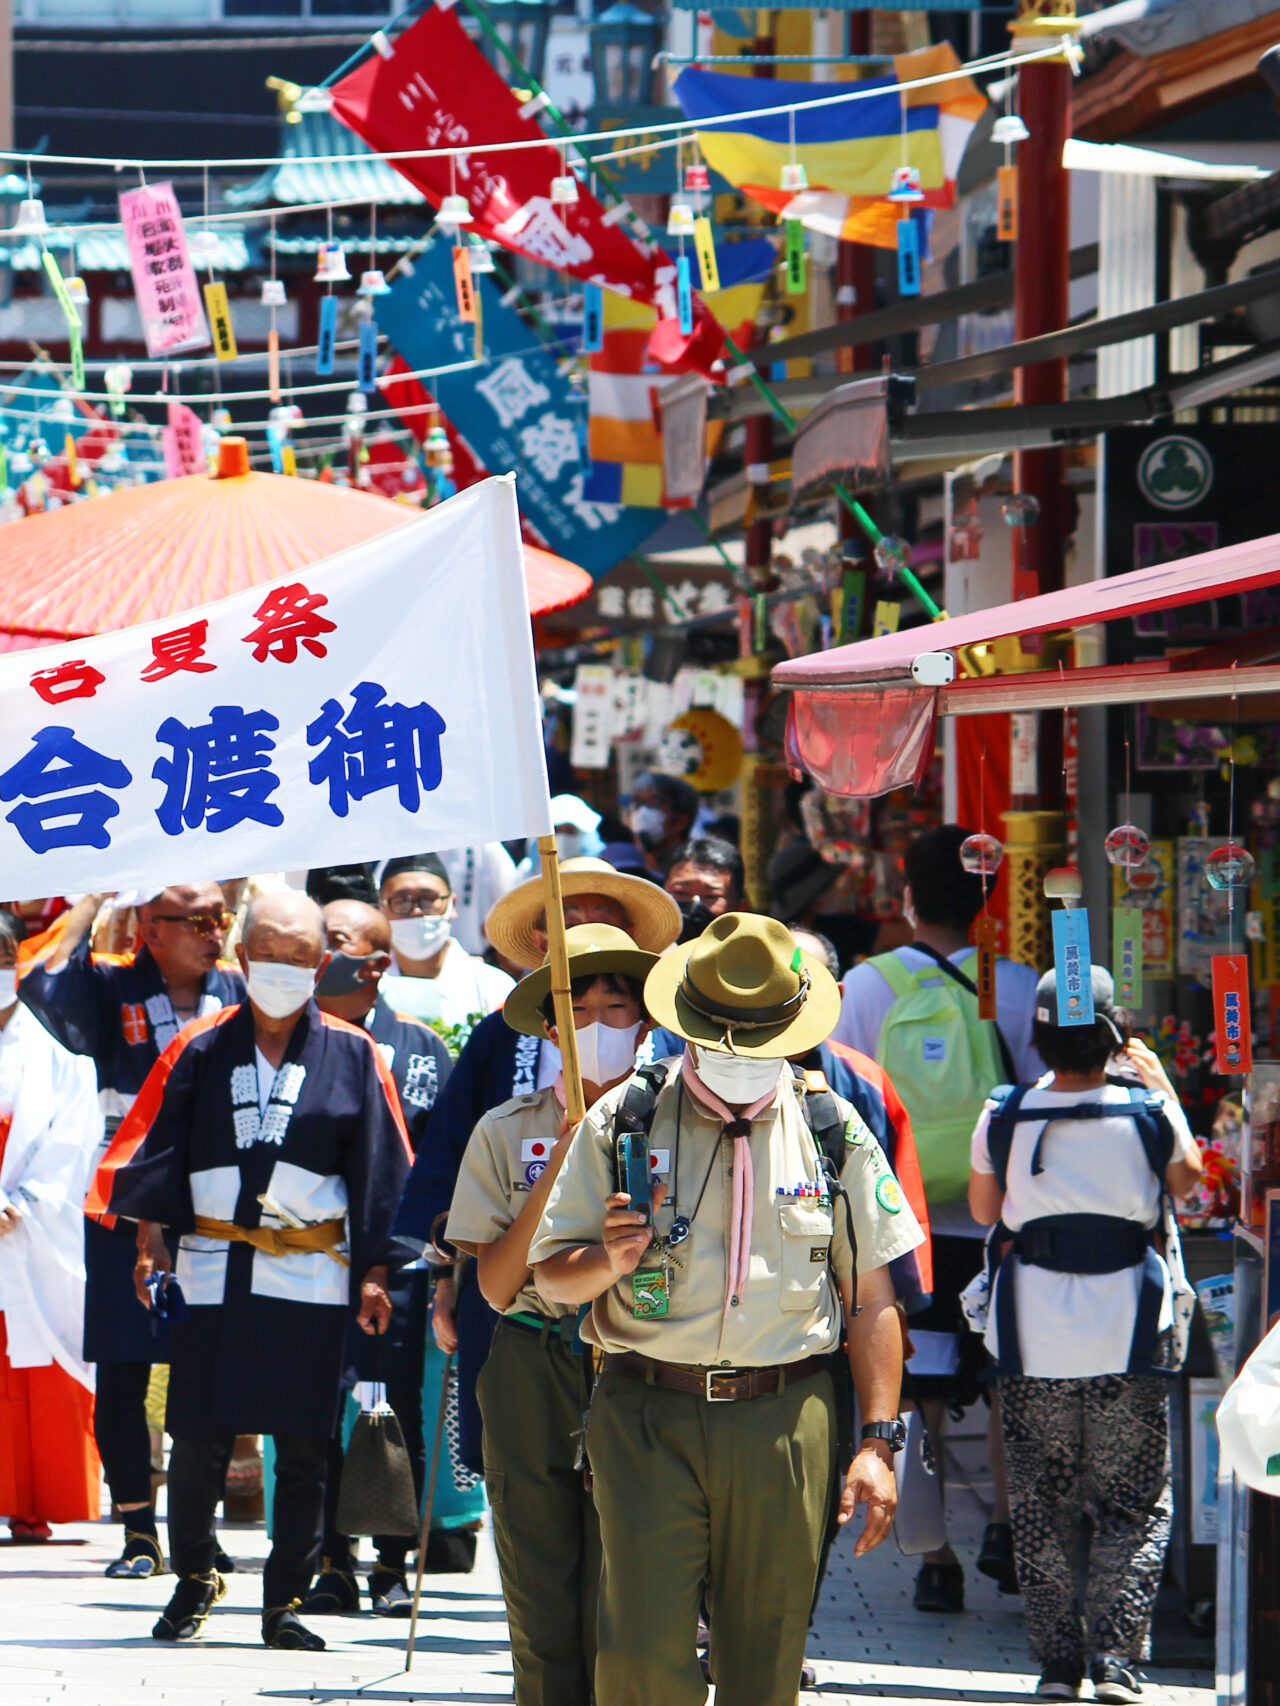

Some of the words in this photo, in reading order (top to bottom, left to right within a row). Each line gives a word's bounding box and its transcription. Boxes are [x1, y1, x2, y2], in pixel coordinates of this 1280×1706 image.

[1064, 945, 1080, 992] 風鈴市
[1225, 992, 1240, 1040] 風鈴市
